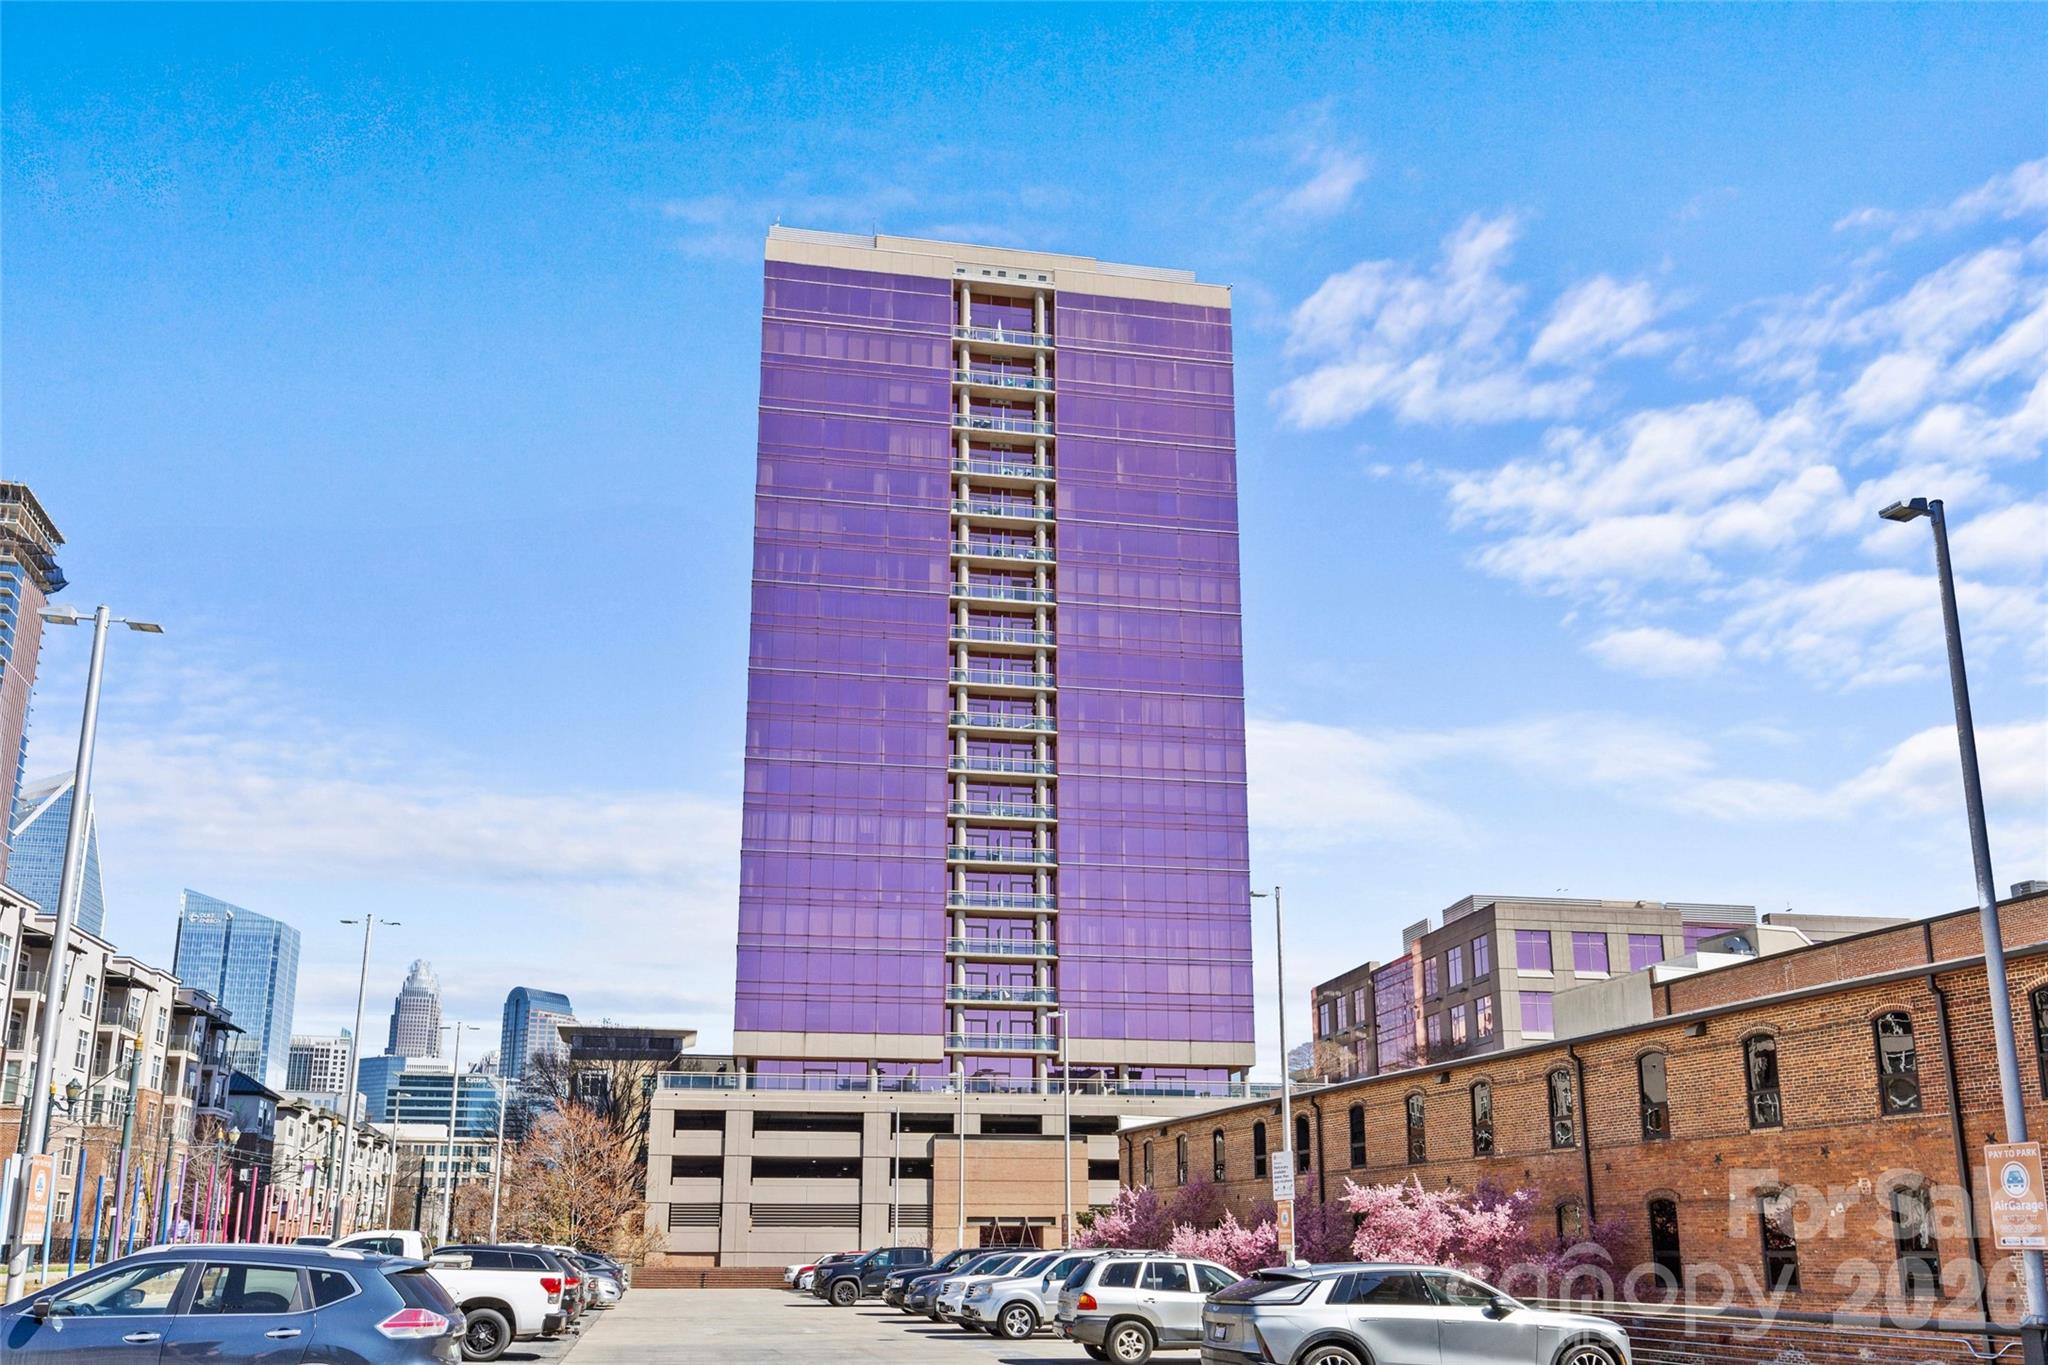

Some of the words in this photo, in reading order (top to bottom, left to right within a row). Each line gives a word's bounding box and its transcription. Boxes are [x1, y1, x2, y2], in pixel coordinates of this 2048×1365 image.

[1988, 1150, 2002, 1159] PAY
[2003, 1149, 2015, 1158] TO
[2016, 1148, 2037, 1157] PARK
[1994, 1201, 2045, 1212] AirGarage
